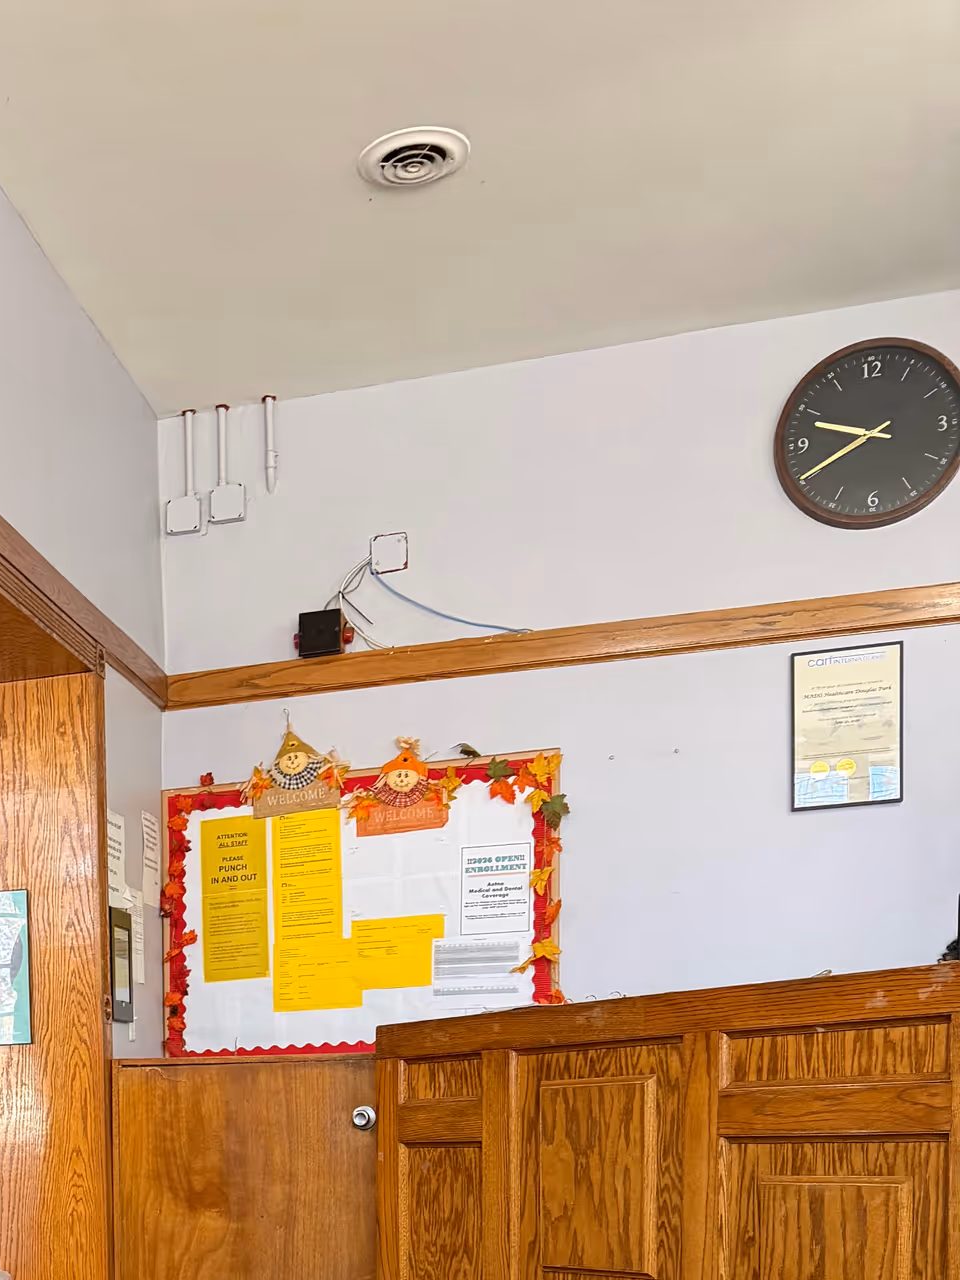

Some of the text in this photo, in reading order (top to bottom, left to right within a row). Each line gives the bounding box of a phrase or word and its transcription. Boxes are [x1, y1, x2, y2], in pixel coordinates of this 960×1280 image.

[862, 361, 882, 379] 12
[936, 414, 948, 432] 3
[797, 437, 809, 454] 9
[867, 490, 879, 507] 6
[267, 788, 326, 807] WELCOME
[374, 807, 434, 823] WELCOME
[218, 863, 248, 873] PUNCH
[464, 863, 527, 874] ENROLLMENT
[211, 873, 258, 885] IN AND OUT
